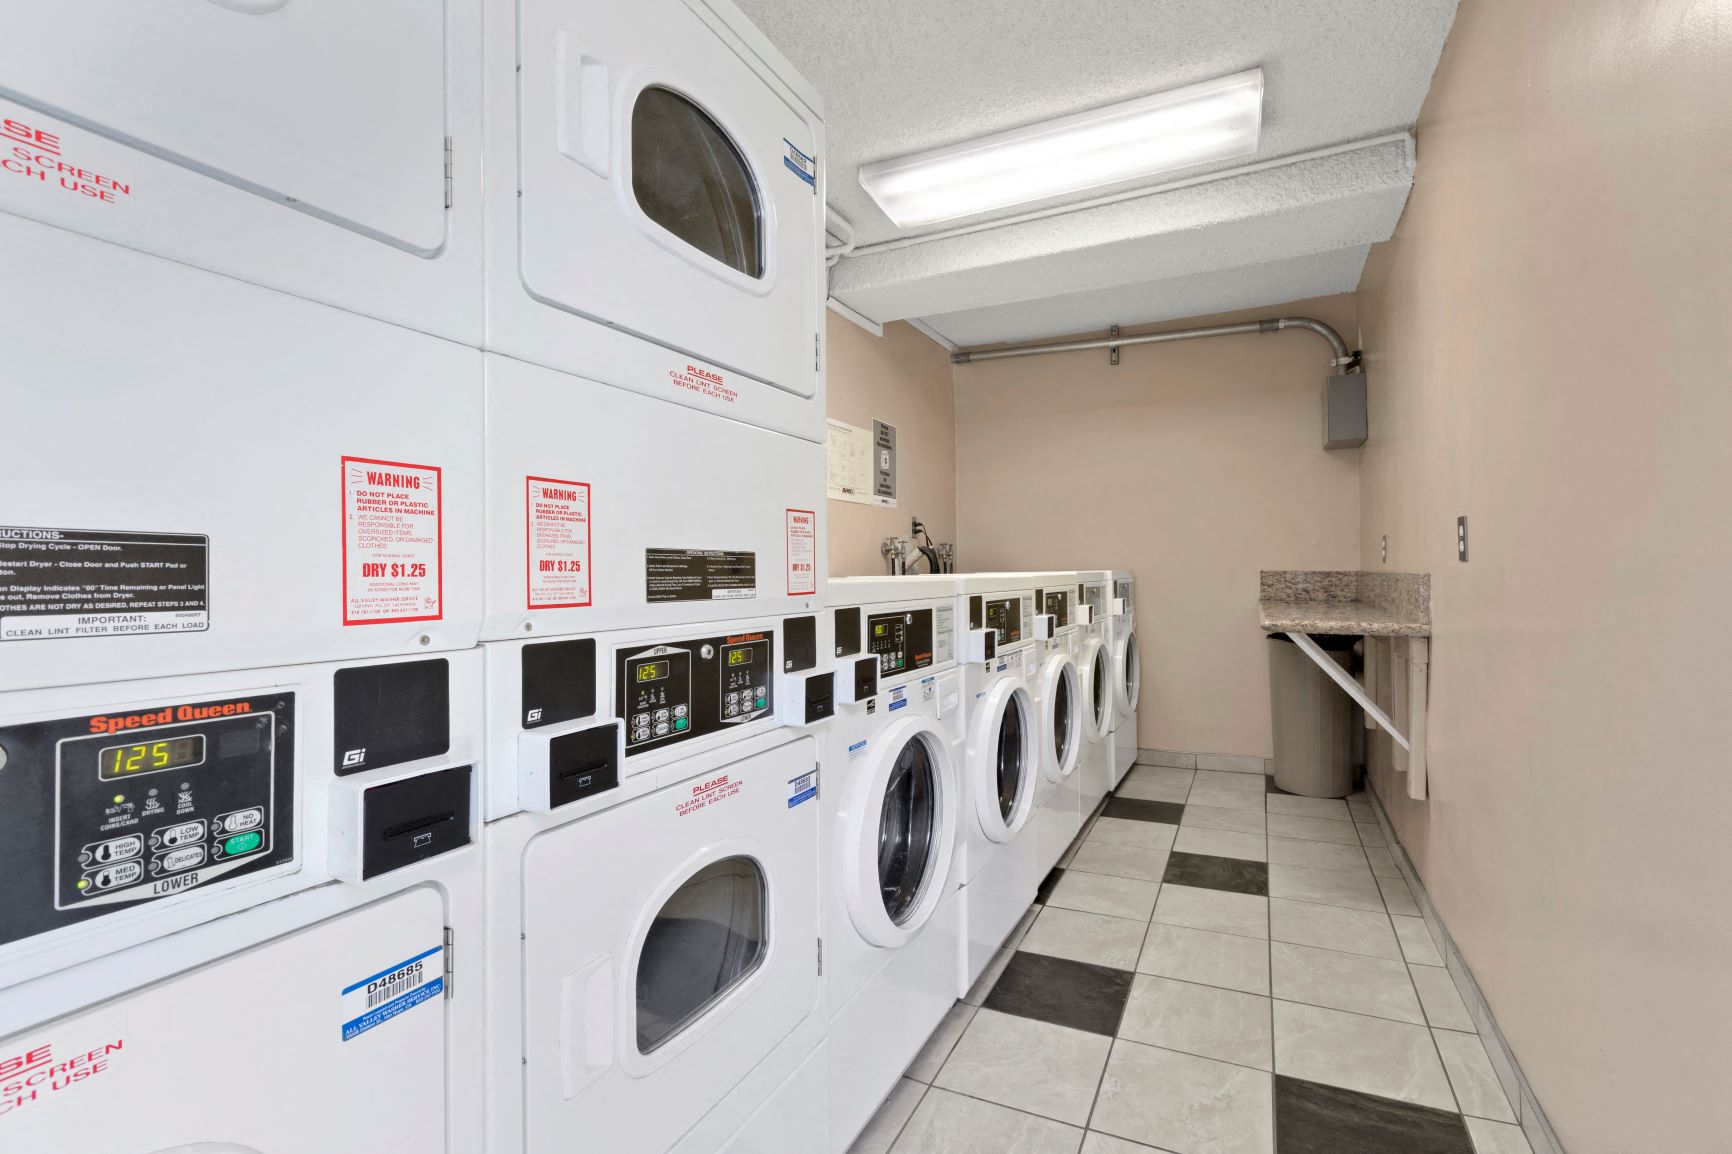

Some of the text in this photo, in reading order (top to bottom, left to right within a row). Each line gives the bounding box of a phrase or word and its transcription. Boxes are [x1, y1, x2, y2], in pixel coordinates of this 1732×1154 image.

[12, 147, 130, 195] SCREEN
[60, 177, 116, 204] USE
[687, 365, 724, 382] PLEASE
[670, 370, 738, 398] CLEAN LINT SCREEN
[673, 379, 735, 402] BEFORE EACH USE
[366, 470, 420, 490] WARNING
[542, 487, 576, 502] WARNING
[0, 530, 64, 540] UCTIONS-
[362, 562, 426, 578] DRY $1.25
[540, 560, 580, 573] DRY $1.25
[78, 615, 147, 625] IMPORTANT:
[726, 636, 745, 645] Speed
[654, 646, 667, 655] UPPER
[639, 665, 656, 680] 125
[89, 700, 251, 734] Speed Queen
[527, 708, 542, 722] Gi
[114, 742, 168, 773] 125
[343, 748, 366, 766] Gi
[693, 775, 728, 794] PLEASE
[676, 780, 743, 811] CLEAN LINT SCREEN
[679, 788, 740, 817] BEFORE EACH USE
[108, 814, 131, 823] INSERT
[142, 807, 164, 817] DRYING
[100, 818, 139, 831] COINS/CARD
[181, 826, 199, 834] LOW
[240, 819, 257, 827] HEAT
[180, 832, 200, 841] TEMP
[230, 834, 254, 845] START
[114, 846, 137, 856] TEMP
[115, 841, 135, 850] HIGH
[174, 852, 202, 863] DELICATES
[114, 871, 137, 882] TEMP
[115, 865, 135, 875] MED
[154, 872, 198, 895] LOWER
[368, 960, 423, 995] D48685
[345, 983, 442, 1036] ALL VALLEY WASHER SERVICE INC
[3, 1040, 122, 1096] SCREEN
[52, 1059, 109, 1090] USE
